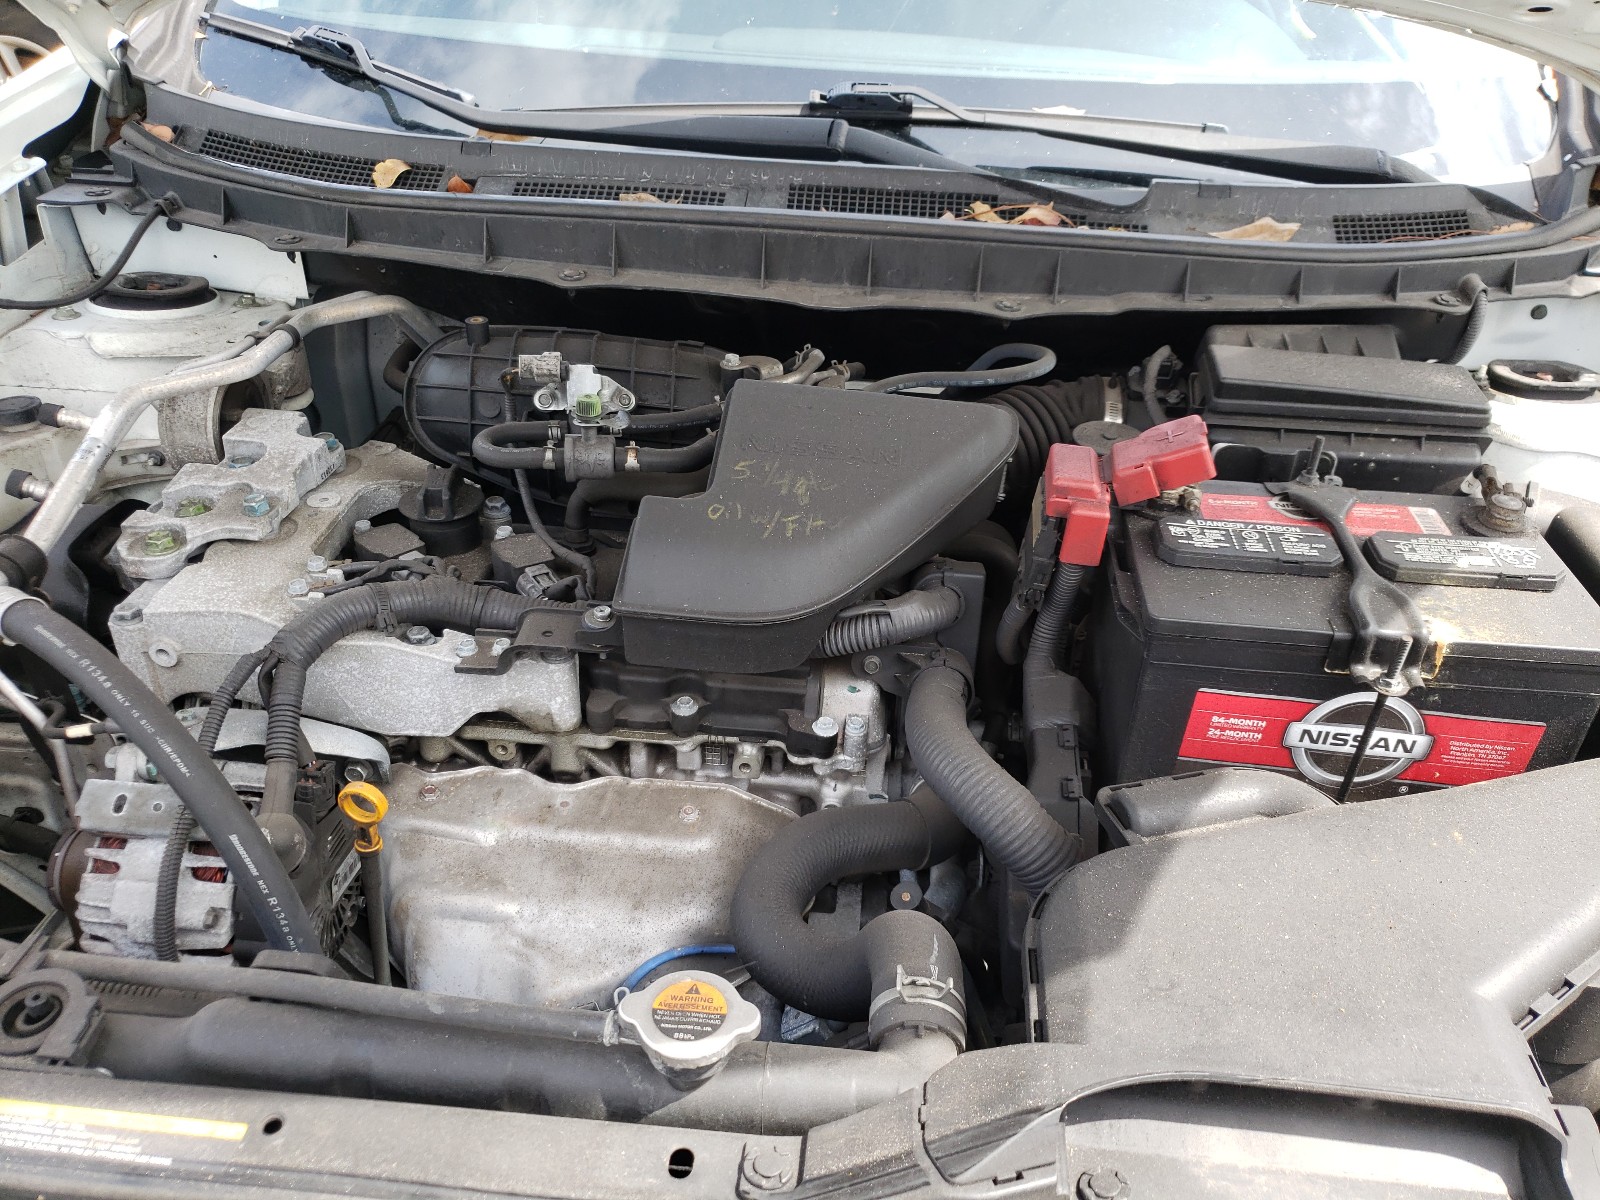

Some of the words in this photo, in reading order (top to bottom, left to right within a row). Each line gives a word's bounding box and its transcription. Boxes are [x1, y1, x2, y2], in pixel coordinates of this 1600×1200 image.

[1196, 519, 1245, 529] DANGER
[1256, 524, 1301, 533] POISON
[110, 689, 132, 708] ONLY
[1211, 716, 1267, 727] 84-MONTH
[1207, 728, 1262, 739] 24-MONTH
[1298, 729, 1418, 754] NISSAN
[1449, 741, 1485, 749] Distributed
[257, 879, 270, 894] NEX
[267, 896, 290, 933] R134a
[286, 935, 300, 953] ONLY
[670, 994, 714, 1004] WARNING
[658, 1001, 724, 1012] AVERTISSEMENT
